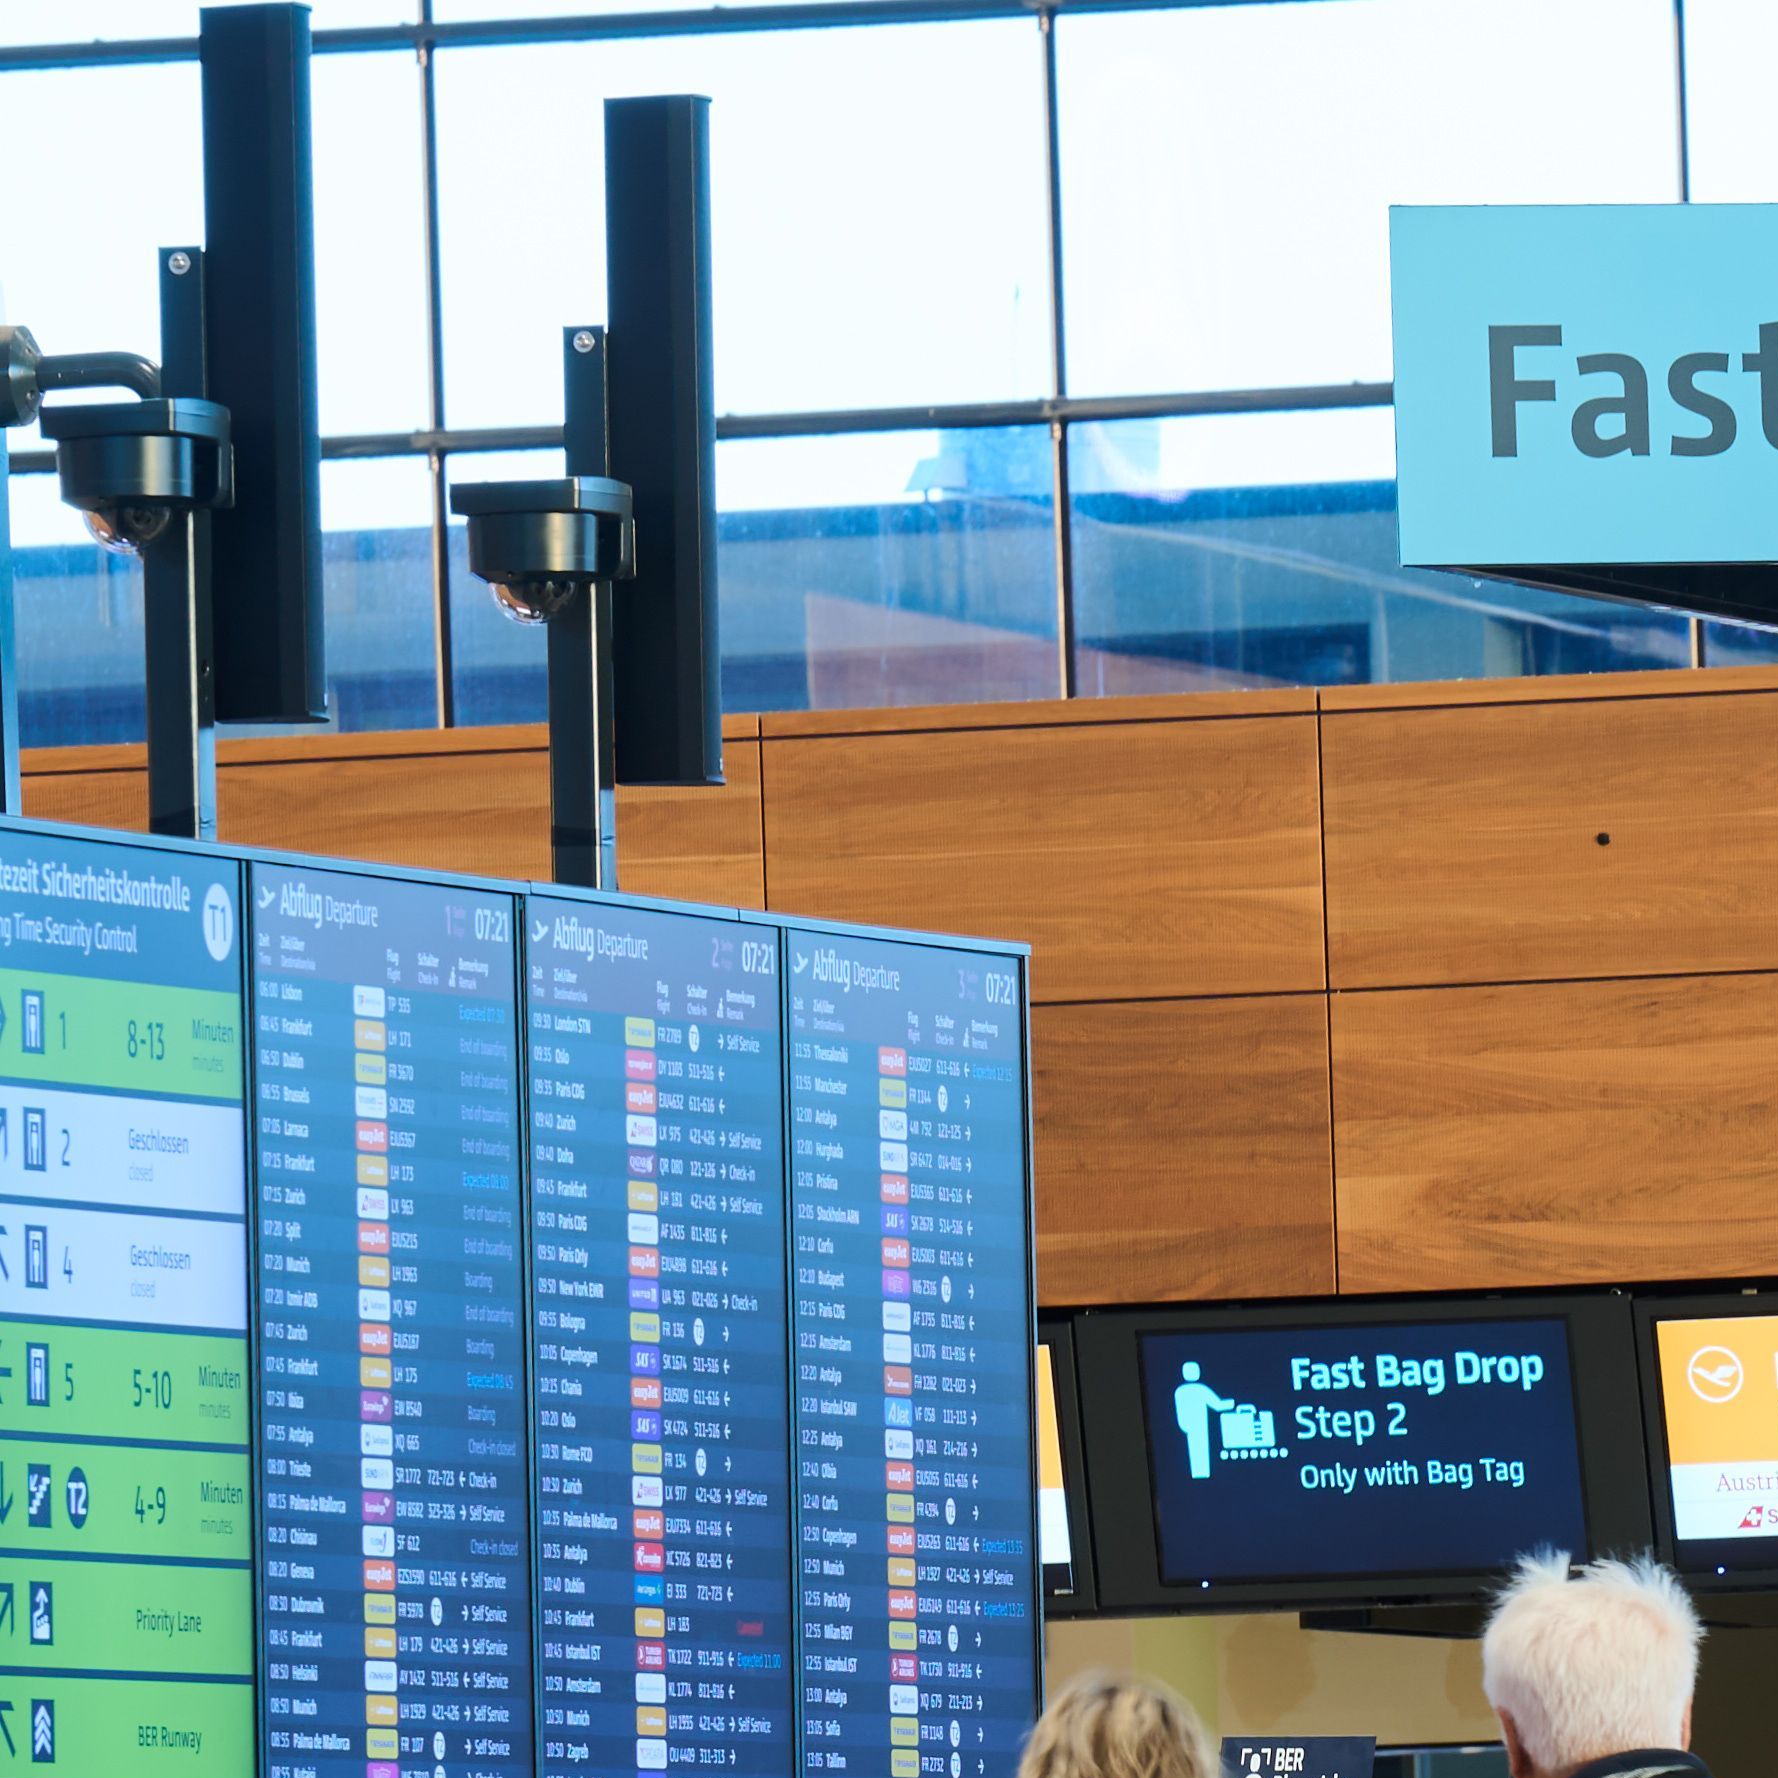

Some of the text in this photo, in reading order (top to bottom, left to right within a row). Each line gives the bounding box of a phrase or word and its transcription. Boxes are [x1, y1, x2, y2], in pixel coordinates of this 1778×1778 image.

[42, 862, 191, 912] Sicherheitskontrolle
[13, 912, 138, 956] Time Security Control
[208, 904, 228, 944] T1
[280, 882, 323, 929] Abflug
[325, 895, 379, 930] Departure
[474, 907, 511, 943] 07:21
[552, 915, 595, 955] Abflug
[597, 927, 649, 962] Departure
[741, 940, 776, 975] 07:21
[812, 946, 852, 988] Abflug
[852, 958, 901, 992] Departure
[984, 972, 1017, 1006] 07:21
[58, 1010, 235, 1062] 1 8-13 Minuten
[60, 1126, 190, 1168] 2 Geschlossen
[128, 1160, 155, 1183] closed
[62, 1244, 192, 1286] 4 Geschlossen
[130, 1277, 157, 1300] closed
[64, 1362, 243, 1411] 5 5-10 Minuten
[1288, 1348, 1546, 1397] Fast Bag Drop
[1294, 1400, 1410, 1445] Step 2
[1298, 1453, 1527, 1493] Only with Bag Tag
[68, 1478, 244, 1526] T2 4-9 Minuten
[135, 1608, 202, 1638] Priority Lane
[138, 1724, 203, 1755] BER Runway
[1274, 1747, 1305, 1772] BER
